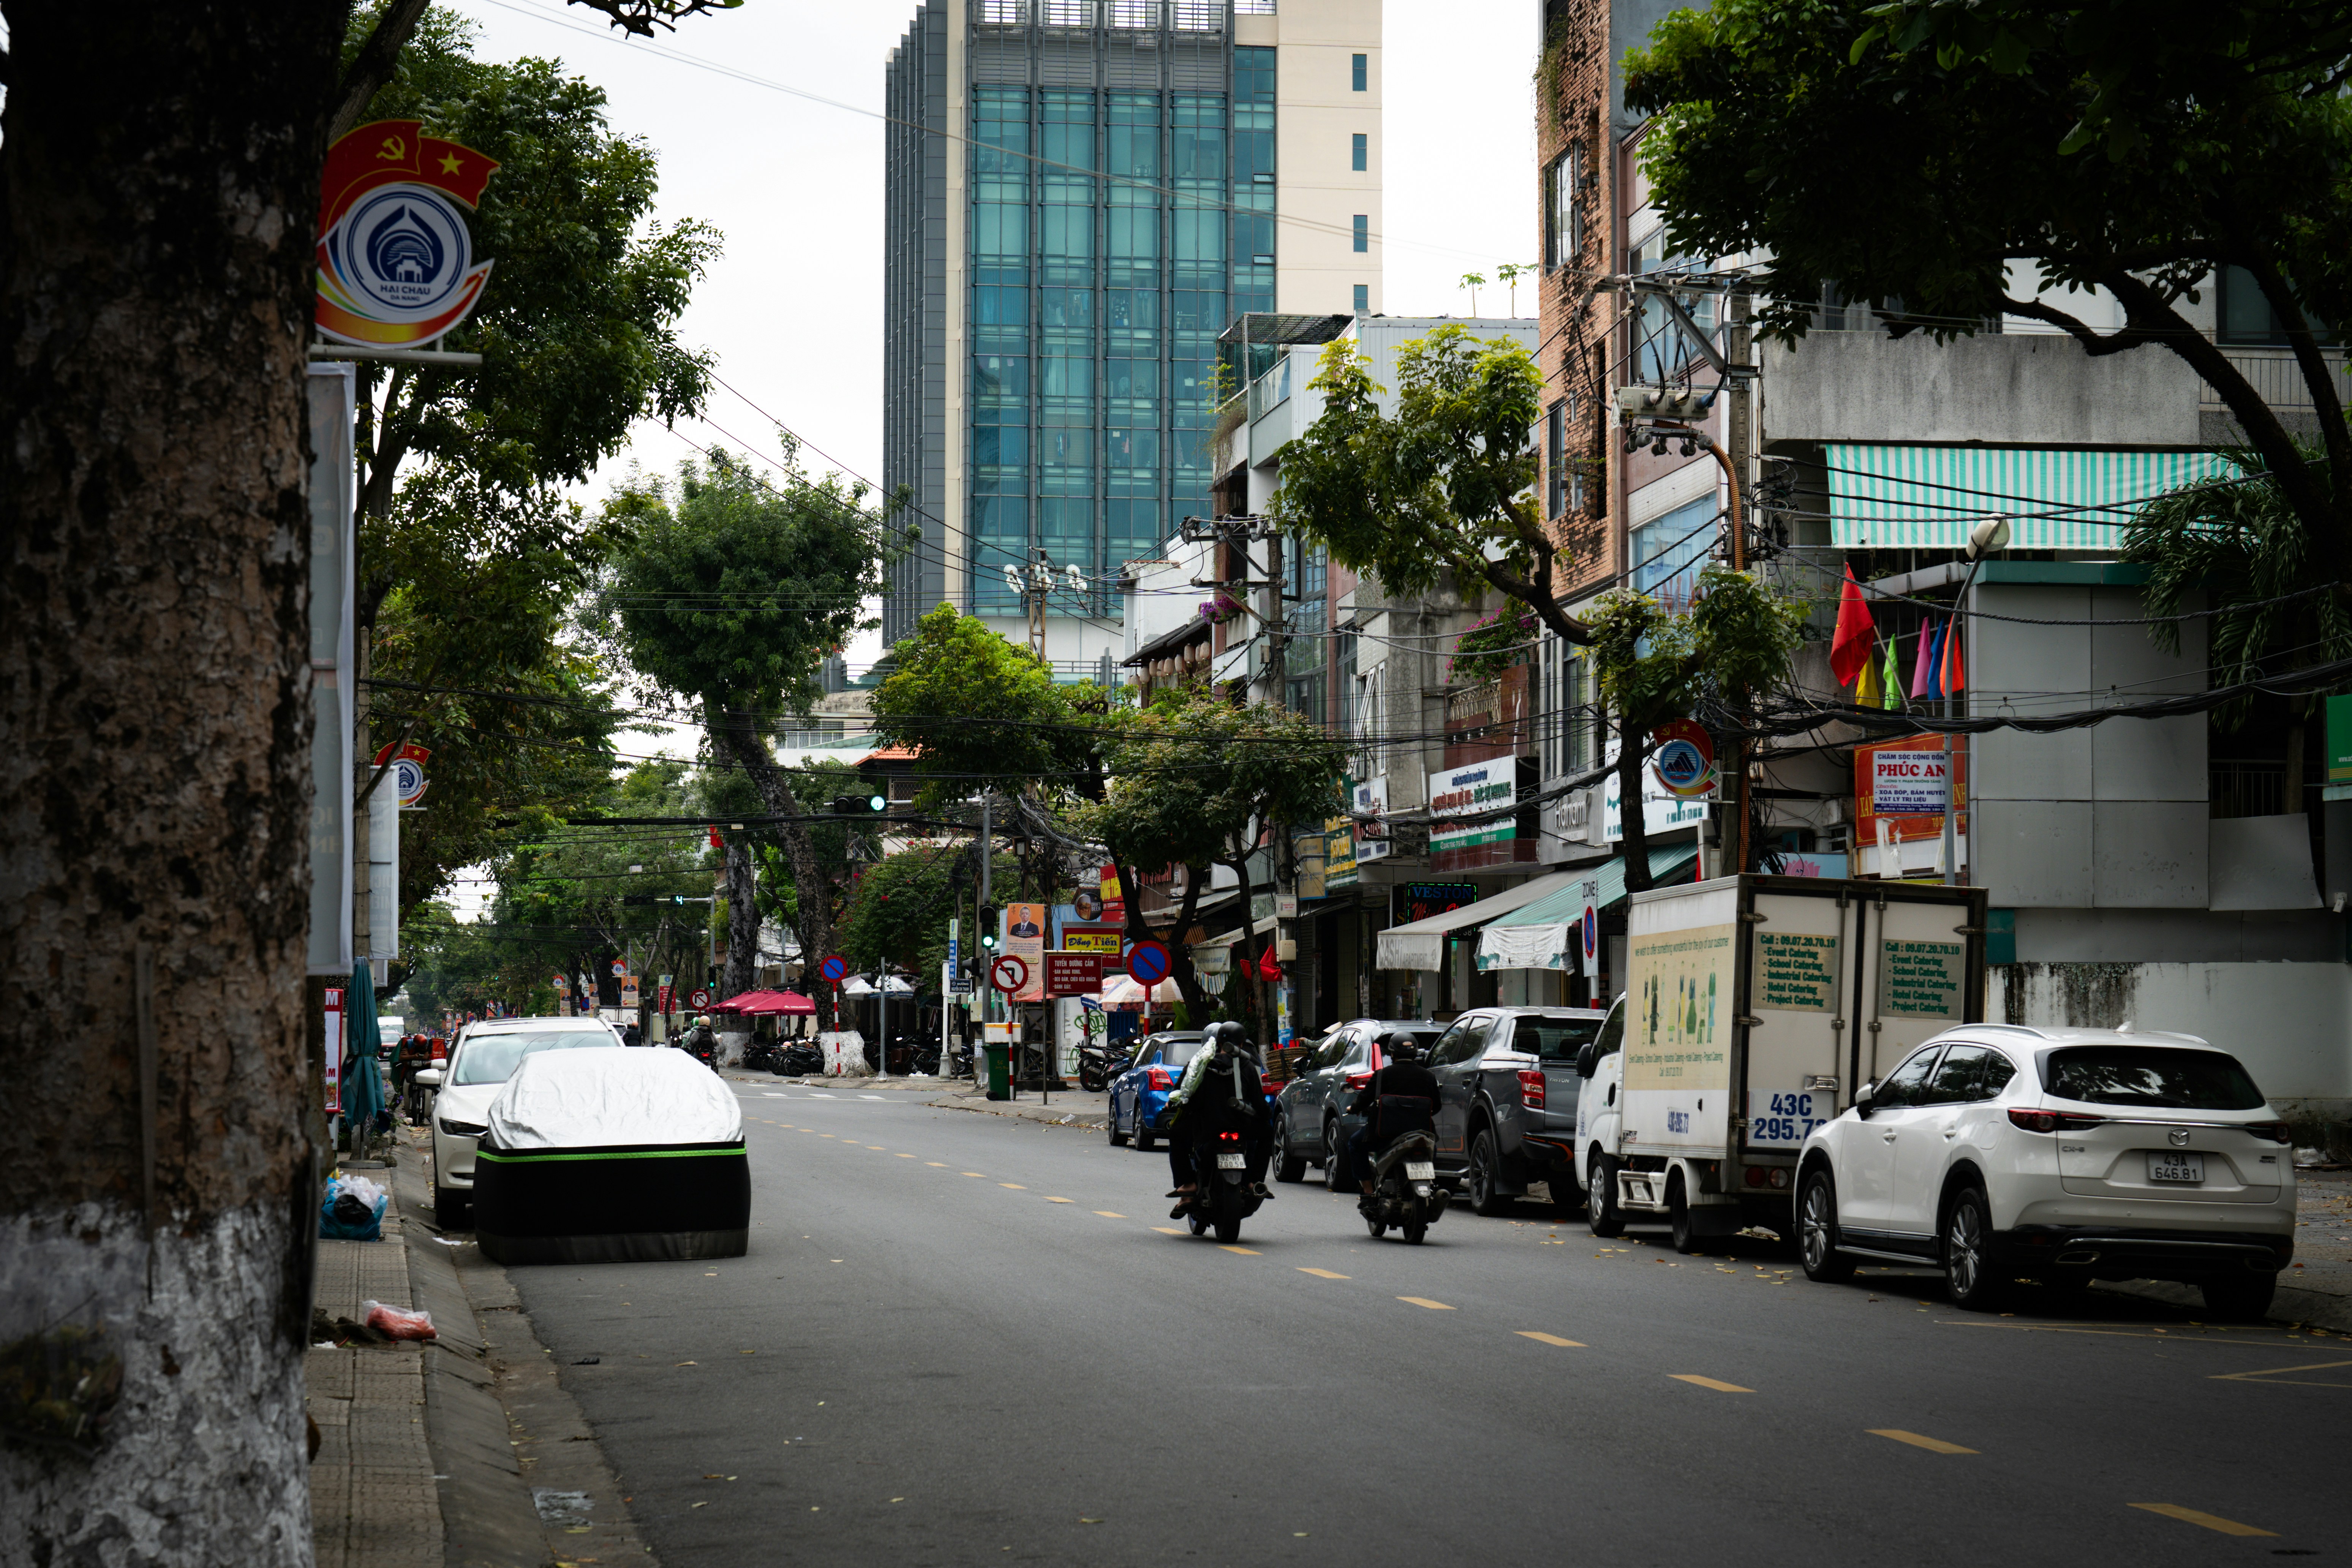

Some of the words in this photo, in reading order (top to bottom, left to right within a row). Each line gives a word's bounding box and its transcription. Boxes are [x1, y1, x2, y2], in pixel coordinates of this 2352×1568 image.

[401, 286, 430, 295] CHAU
[1877, 761, 1919, 776] PHÚC
[1412, 887, 1472, 899] VESTON
[1583, 881, 1595, 898] ZONE
[676, 896, 683, 905] 4
[1068, 937, 1091, 948] Đồng
[1092, 936, 1117, 946] Tiến
[1657, 942, 1672, 955] something
[1673, 939, 1687, 952] wonderful
[1714, 936, 1729, 948] customer
[1761, 935, 1774, 944] Call
[1781, 936, 1835, 948] 09.07.20.70.10
[1789, 948, 1819, 961] Catering
[1886, 942, 1899, 952] Call
[1905, 943, 1960, 955] 09.07.20.70.10
[1054, 958, 1067, 967] TUYẾN
[1069, 958, 1083, 967] ĐƯỜNG
[1085, 958, 1094, 967] CẤM
[1402, 953, 1427, 967] APARTMENT
[1768, 958, 1791, 968] School
[1794, 960, 1823, 972] Catering
[1914, 955, 1943, 967] Catering
[1768, 970, 1801, 980] Industrial
[1803, 972, 1832, 984] Catering
[1893, 966, 1916, 976] School
[1918, 967, 1947, 979] Catering
[1768, 982, 1786, 992] Hotel
[1788, 983, 1818, 995] Catering
[1893, 977, 1926, 988] Industrial
[1927, 979, 1957, 991] Catering
[1767, 994, 1792, 1005] Project
[1794, 995, 1824, 1007] Catering
[1893, 989, 1911, 999] Hotel
[1913, 991, 1943, 1003] Catering
[1892, 1001, 1917, 1012] Project
[1919, 1002, 1949, 1015] Catering
[1635, 1054, 1644, 1065] Catering
[1653, 1053, 1662, 1065] Catering
[1664, 1053, 1674, 1062] Industrial
[1675, 1053, 1684, 1064] Catering
[1693, 1052, 1702, 1064] Catering
[1712, 1051, 1723, 1064] Catering
[1770, 1094, 1812, 1116] 43C
[2164, 1155, 2187, 1167] 43A
[2155, 1167, 2197, 1180] 646.81
